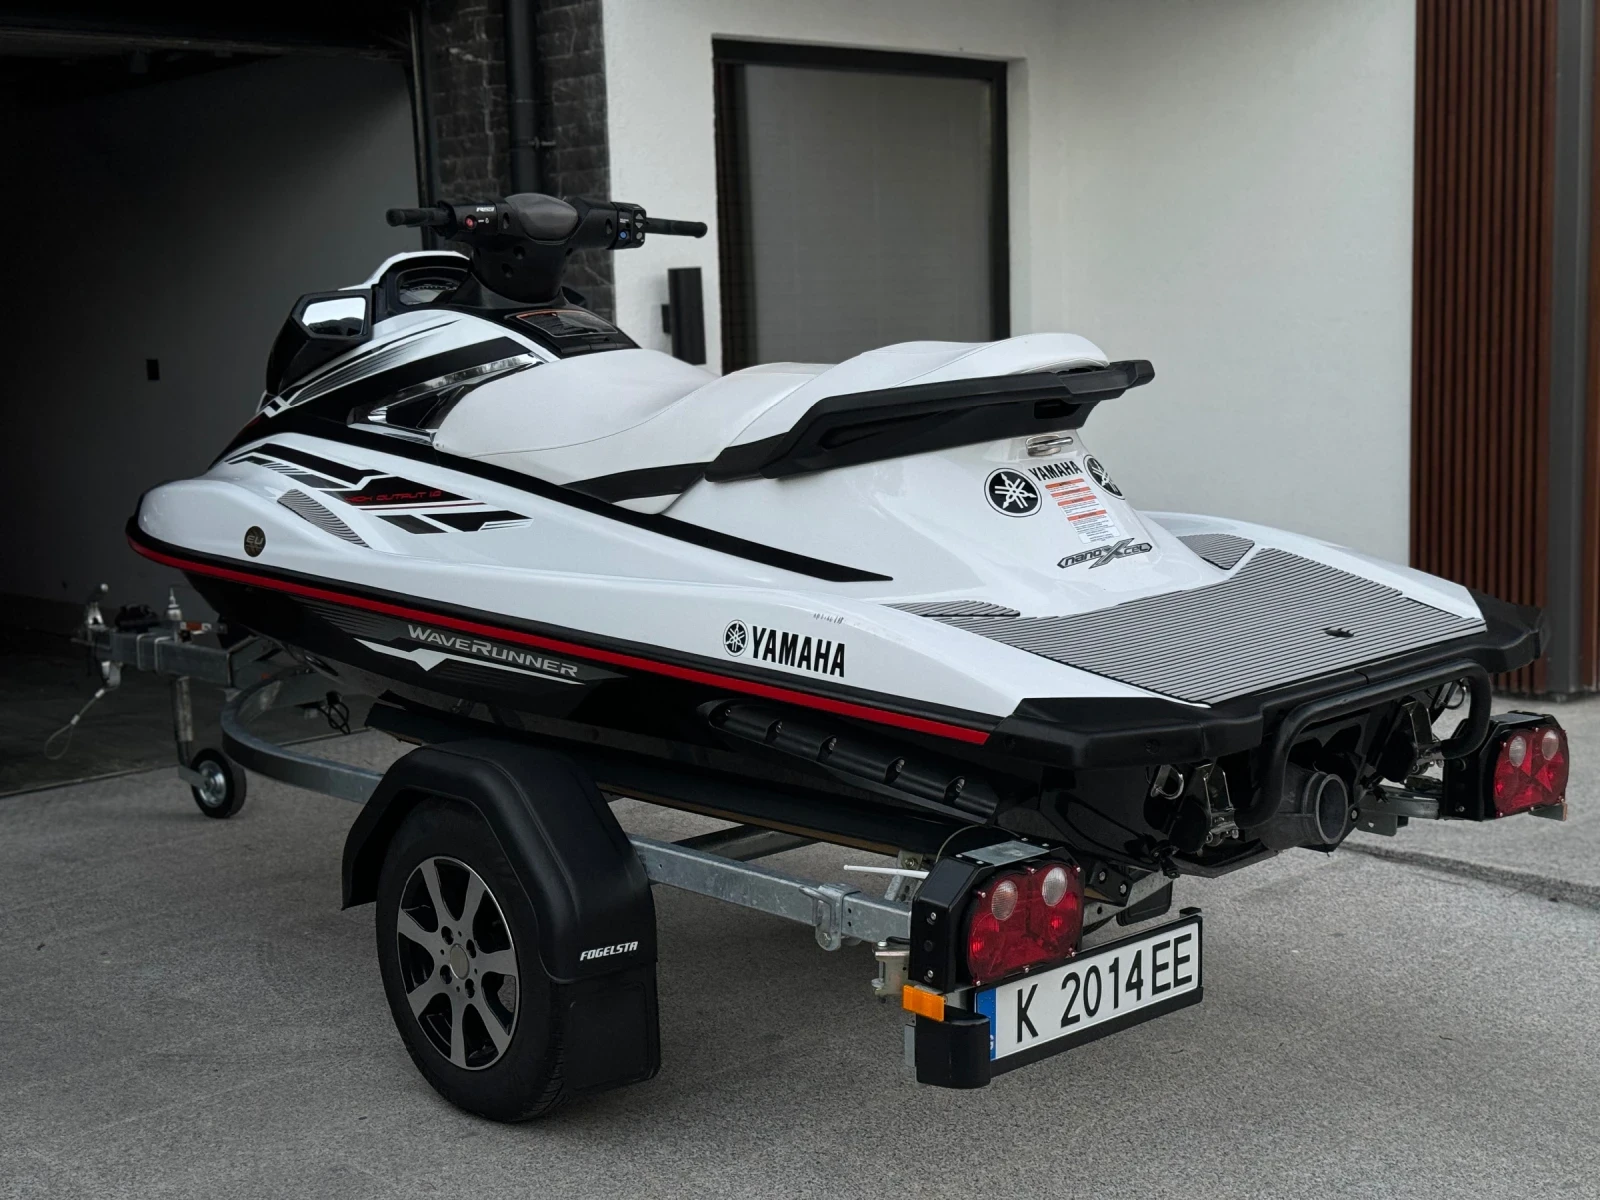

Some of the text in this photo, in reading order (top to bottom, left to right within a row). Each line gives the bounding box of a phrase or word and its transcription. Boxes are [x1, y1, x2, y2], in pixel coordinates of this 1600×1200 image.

[1028, 460, 1083, 482] YAMAHA
[376, 491, 427, 501] OUTPUT
[407, 624, 578, 678] WAVERUNNER
[752, 625, 846, 678] YAMAHA
[579, 941, 639, 961] FOGELSTA
[1016, 932, 1193, 1044] K 2014EE
